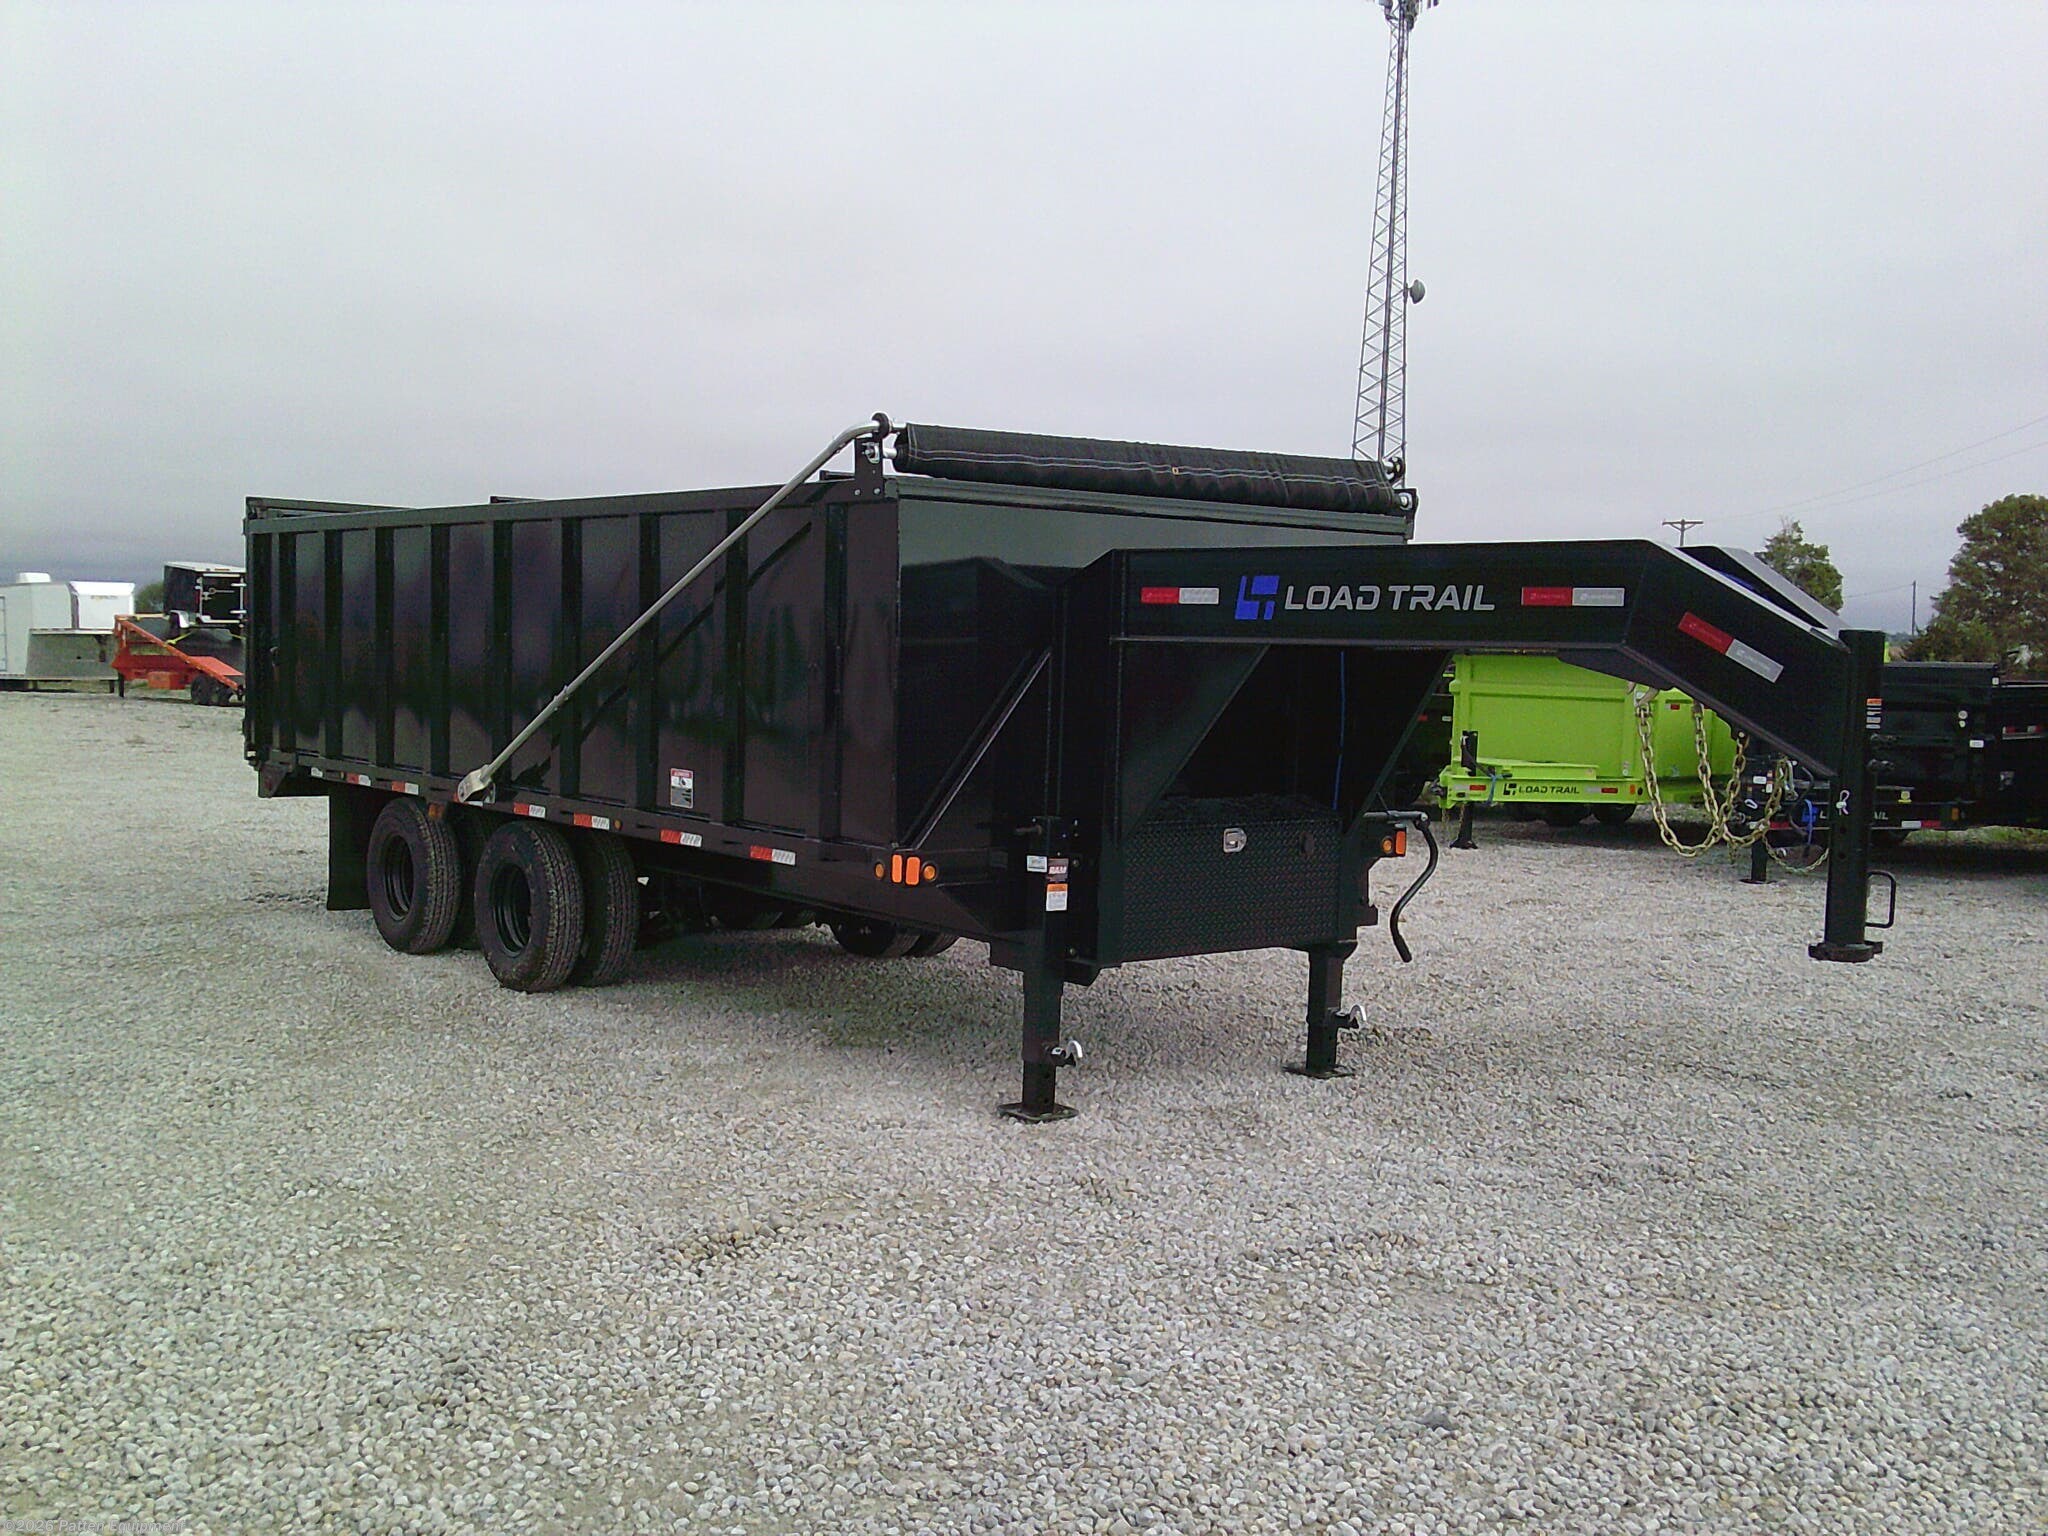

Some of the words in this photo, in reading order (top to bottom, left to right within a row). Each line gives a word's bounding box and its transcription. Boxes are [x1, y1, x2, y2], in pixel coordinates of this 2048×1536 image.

[1284, 585, 1381, 610] LOAD
[1388, 584, 1496, 611] TRAIL
[1518, 785, 1548, 794] LOAD
[1550, 785, 1580, 794] TRAIL
